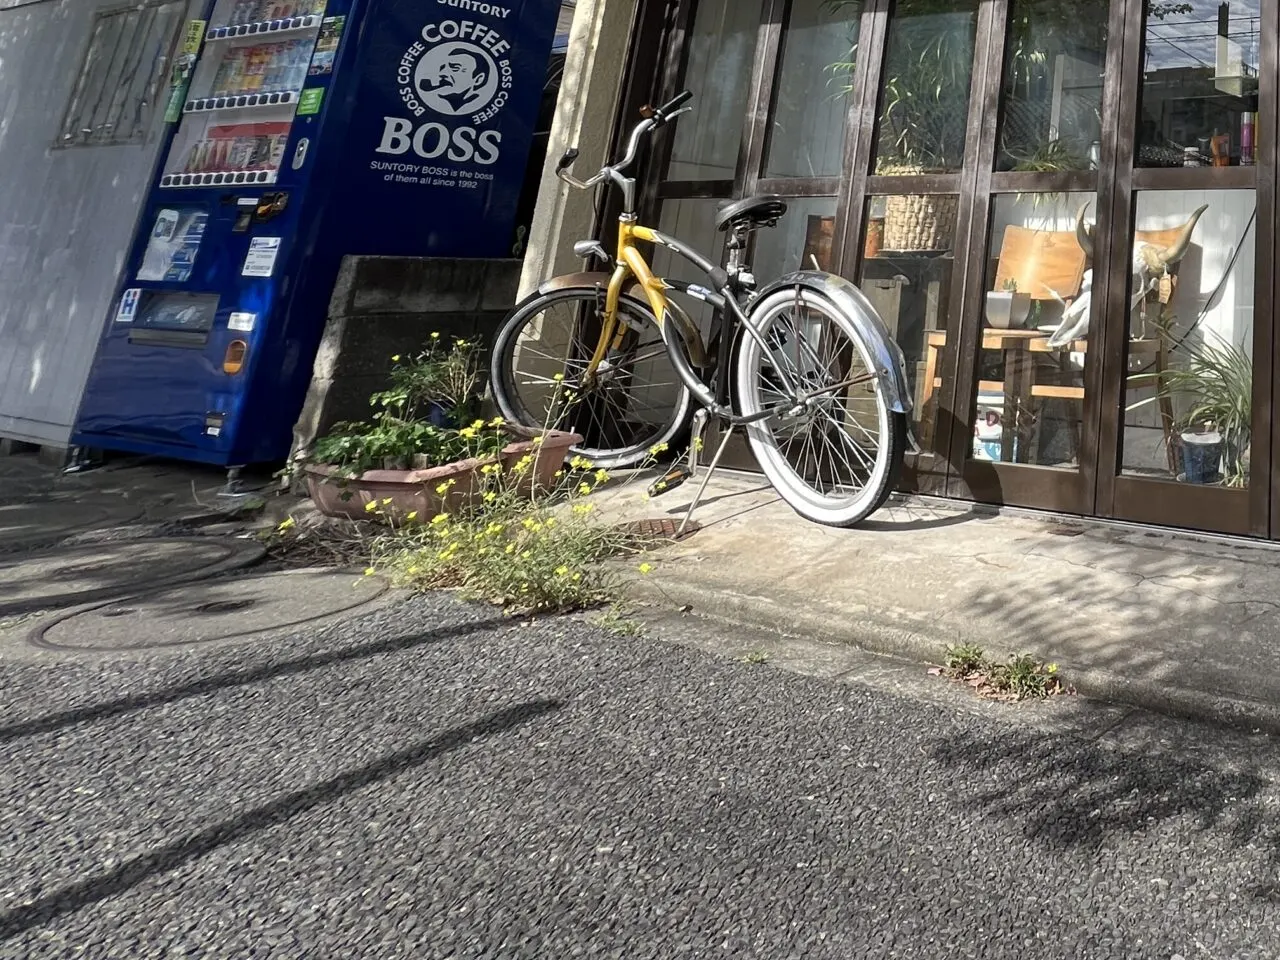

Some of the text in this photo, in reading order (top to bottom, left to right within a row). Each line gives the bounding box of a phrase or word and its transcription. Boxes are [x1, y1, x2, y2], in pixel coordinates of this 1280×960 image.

[421, 20, 511, 58] COFFEE
[397, 41, 426, 117] BOSS COFFEE
[472, 59, 513, 125] BOSS COFFEE
[375, 116, 502, 165] BOSS
[370, 161, 494, 180] SUNTORY BOSS is the boss
[384, 173, 478, 189] of them all since 1992
